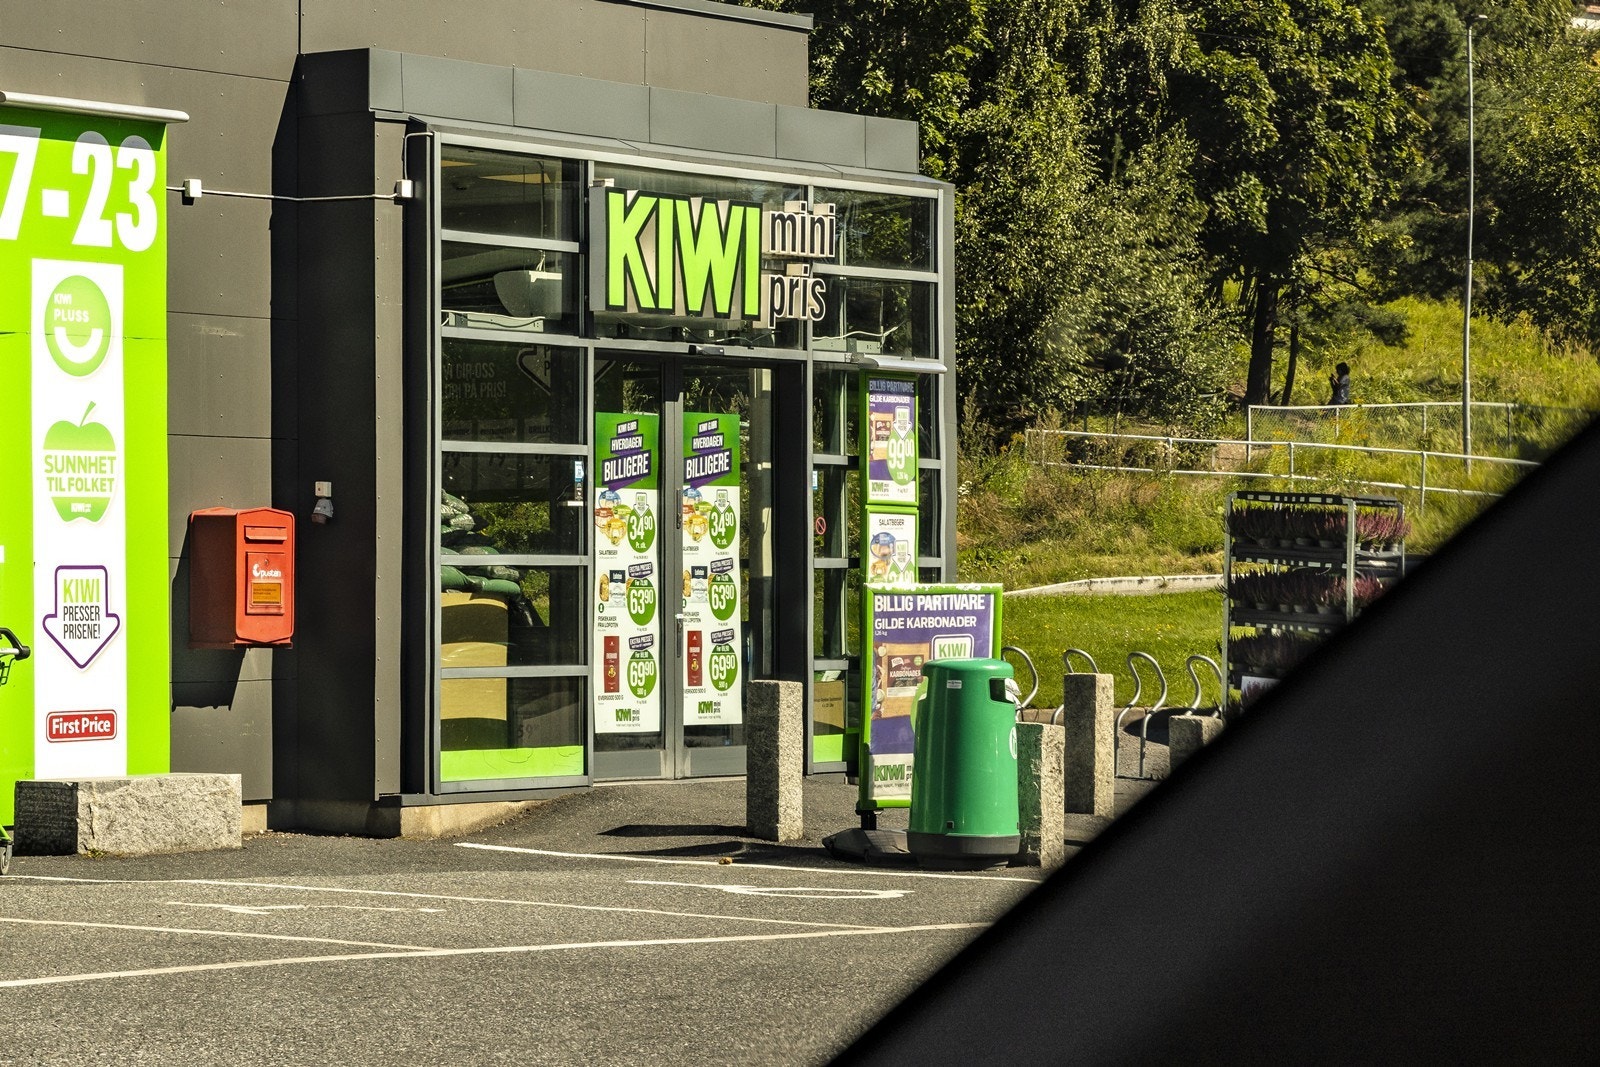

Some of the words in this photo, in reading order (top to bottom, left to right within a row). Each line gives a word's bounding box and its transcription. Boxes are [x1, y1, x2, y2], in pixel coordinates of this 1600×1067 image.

[769, 200, 836, 258] mini
[607, 188, 762, 320] KIWI
[53, 292, 72, 305] KIWI
[768, 263, 827, 330] pris
[53, 308, 90, 323] PLUSS
[476, 362, 496, 379] OSS
[479, 380, 507, 397] PRIS!
[869, 381, 887, 392] BILLIG
[887, 382, 915, 394] PARTIVARE
[869, 394, 883, 403] GILDE
[611, 436, 643, 451] HVERDAGEN
[692, 434, 724, 450] HVERDAGEN
[44, 454, 117, 475] SUNNHET
[604, 452, 649, 482] BILLIGERE
[686, 451, 730, 480] BILLIGERE
[46, 476, 66, 492] TIL
[67, 477, 115, 493] FOLKET
[878, 518, 905, 526] SALATBEGER
[63, 579, 100, 603] KIWI
[874, 595, 914, 612] BILLIG
[916, 593, 986, 611] PARTIVARE
[63, 605, 101, 622] PRESSER
[63, 623, 101, 639] PRISENE!
[874, 617, 905, 630] GILDE
[906, 615, 977, 629] KARBONADER
[938, 643, 967, 658] KIWI
[615, 708, 632, 722] KIWI
[698, 701, 713, 714] KIWI
[52, 718, 80, 735] First
[81, 716, 111, 734] Price
[874, 764, 905, 782] KIWI
